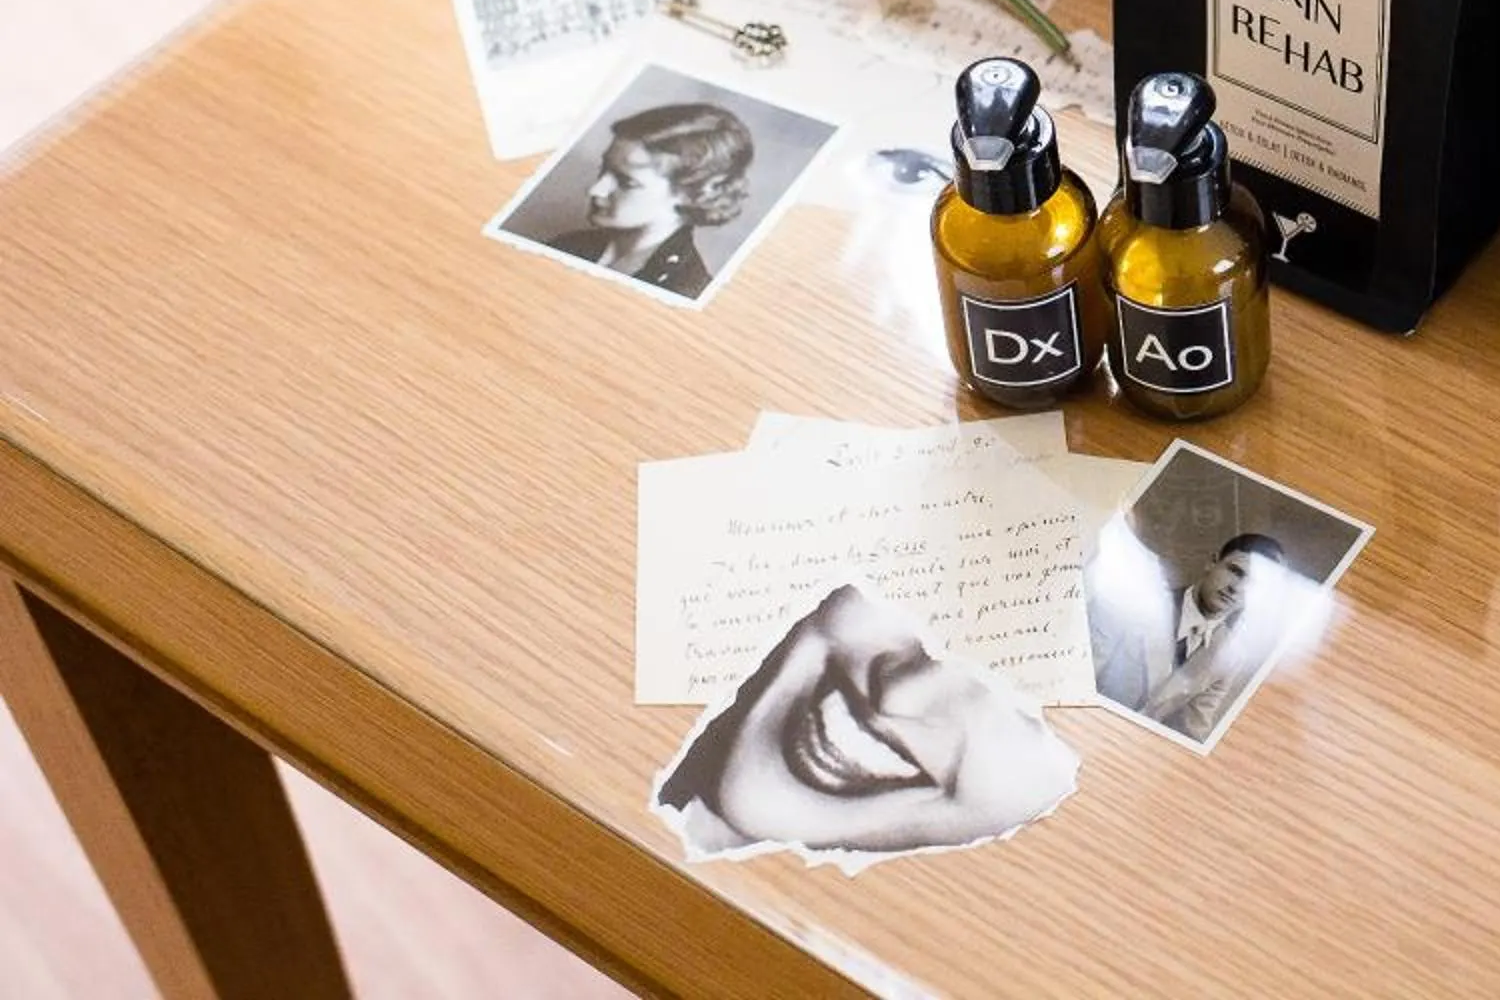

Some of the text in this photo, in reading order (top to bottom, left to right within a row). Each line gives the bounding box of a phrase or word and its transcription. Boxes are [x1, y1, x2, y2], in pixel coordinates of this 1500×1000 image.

[1232, 3, 1364, 94] REHAB
[984, 327, 1065, 364] Dx
[1135, 333, 1214, 371] Ao
